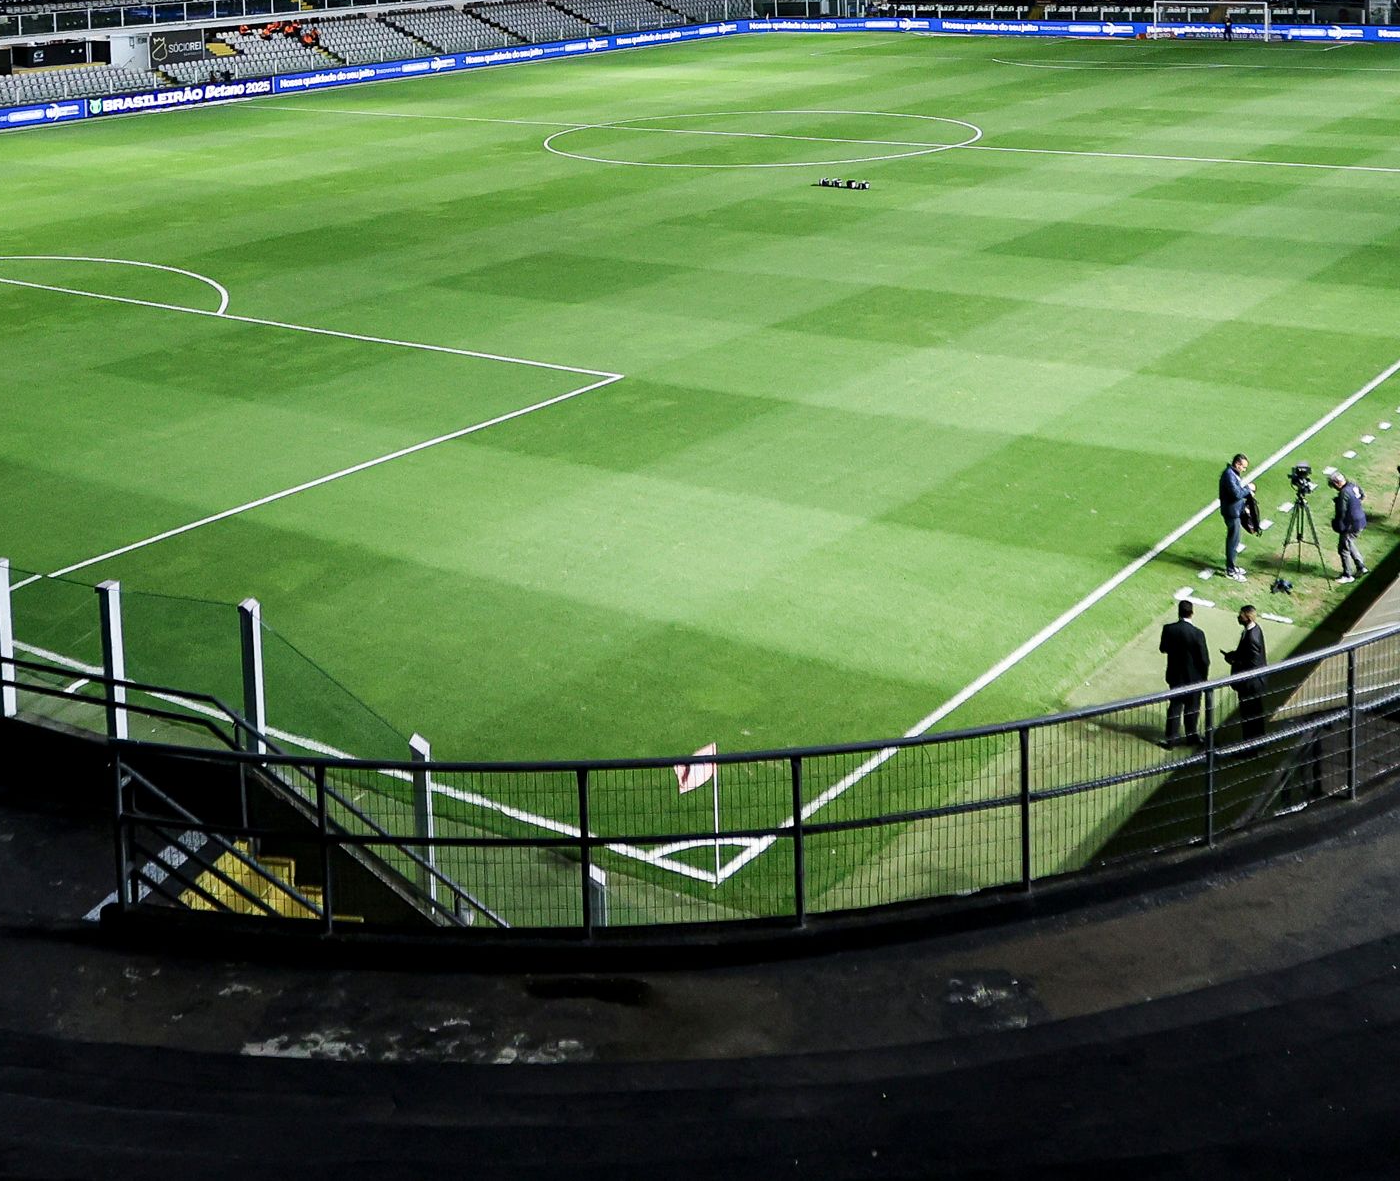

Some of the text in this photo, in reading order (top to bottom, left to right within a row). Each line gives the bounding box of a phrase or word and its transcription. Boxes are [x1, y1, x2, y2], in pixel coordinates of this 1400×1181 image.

[103, 80, 270, 112] BRASILEIRÃO Betano 2025
